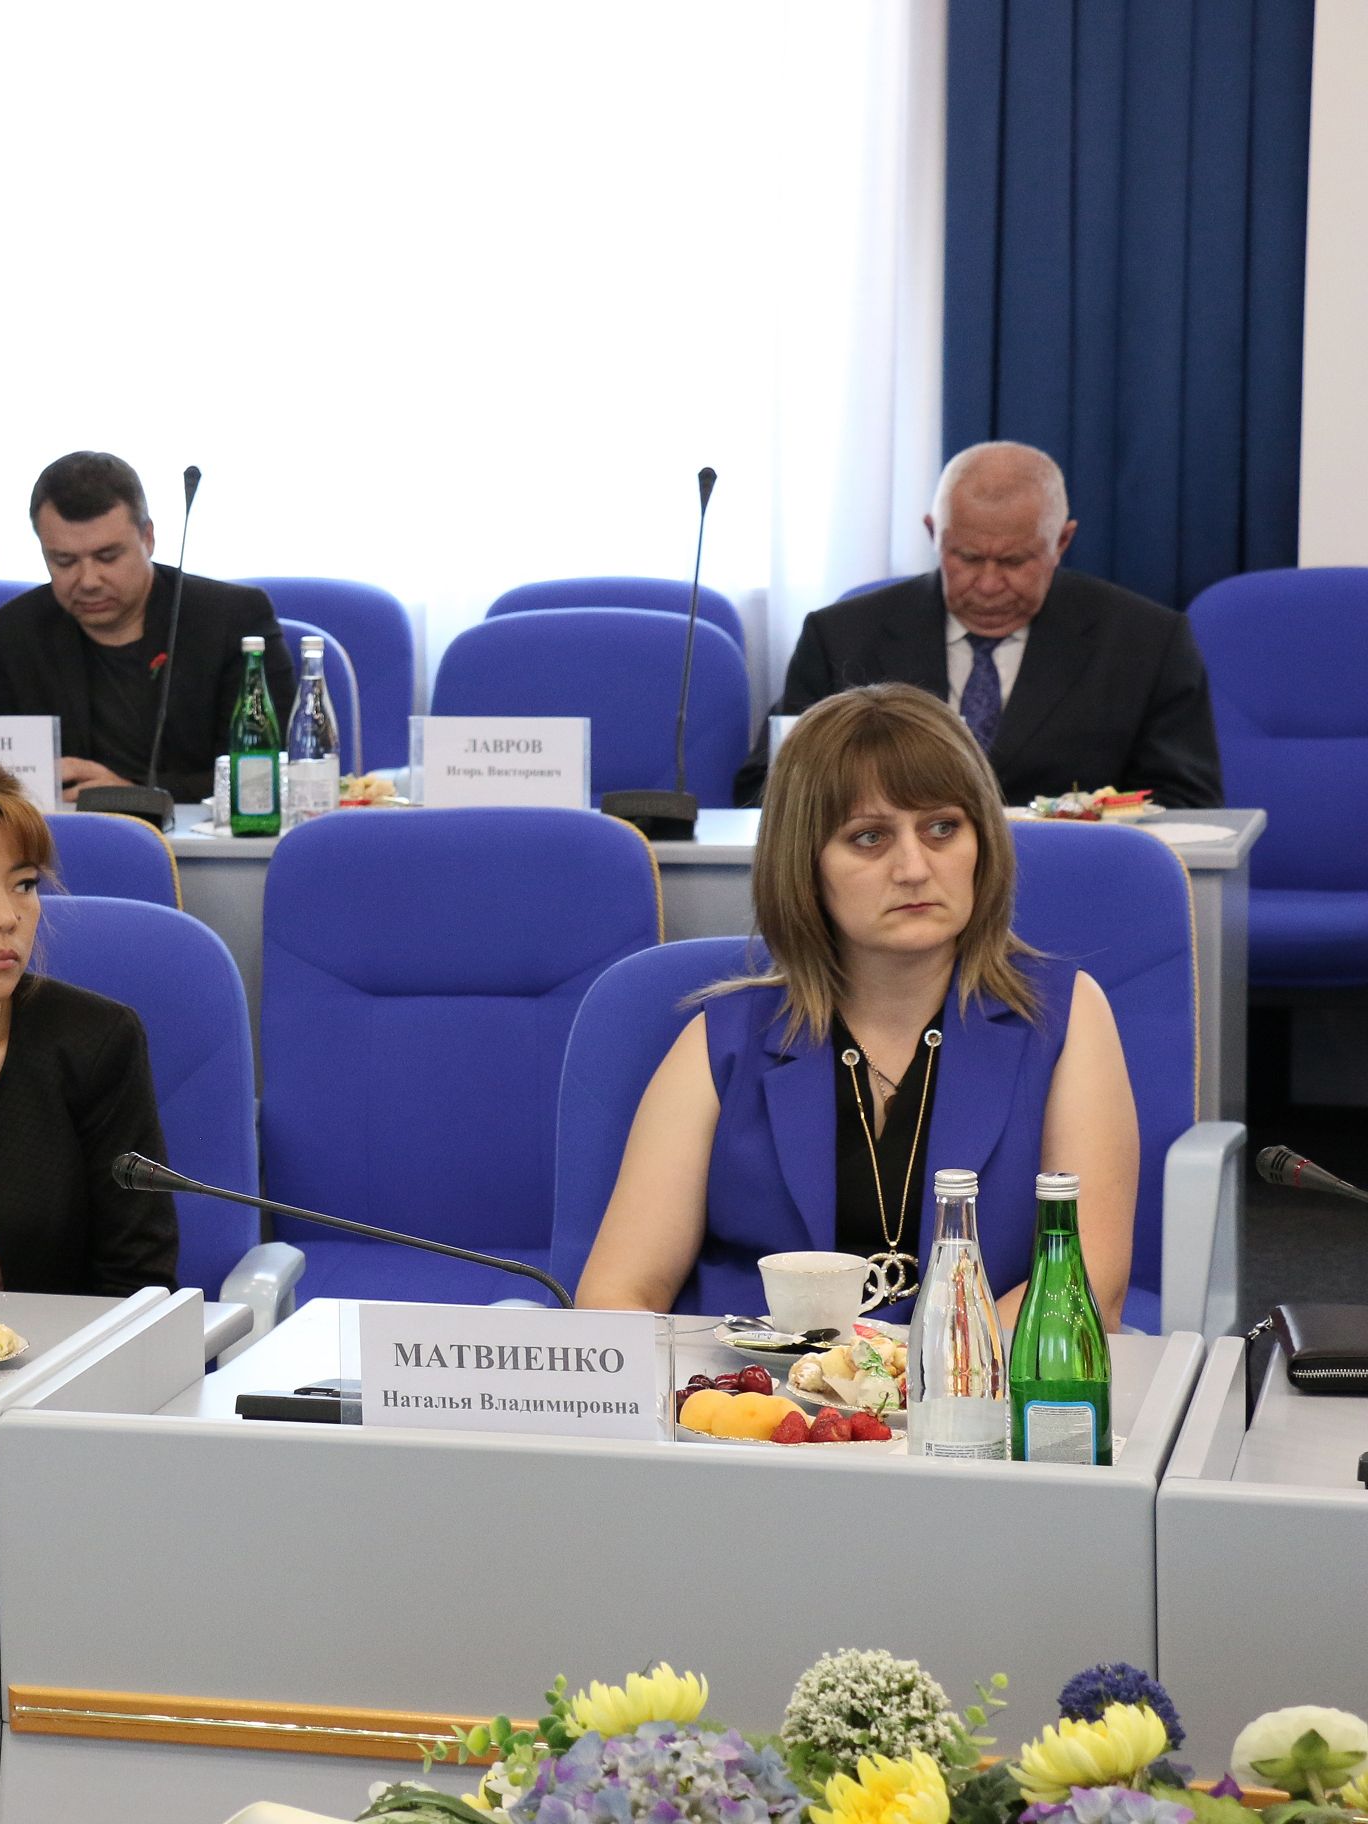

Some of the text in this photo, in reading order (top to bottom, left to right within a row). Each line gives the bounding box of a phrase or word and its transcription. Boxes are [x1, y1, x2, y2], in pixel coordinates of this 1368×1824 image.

[464, 738, 543, 754] ЛАВРОВ
[446, 765, 562, 778] Игорь Викторович
[393, 1342, 625, 1374] МАТВИЕНКО
[382, 1390, 640, 1418] Наталья Владимировна
